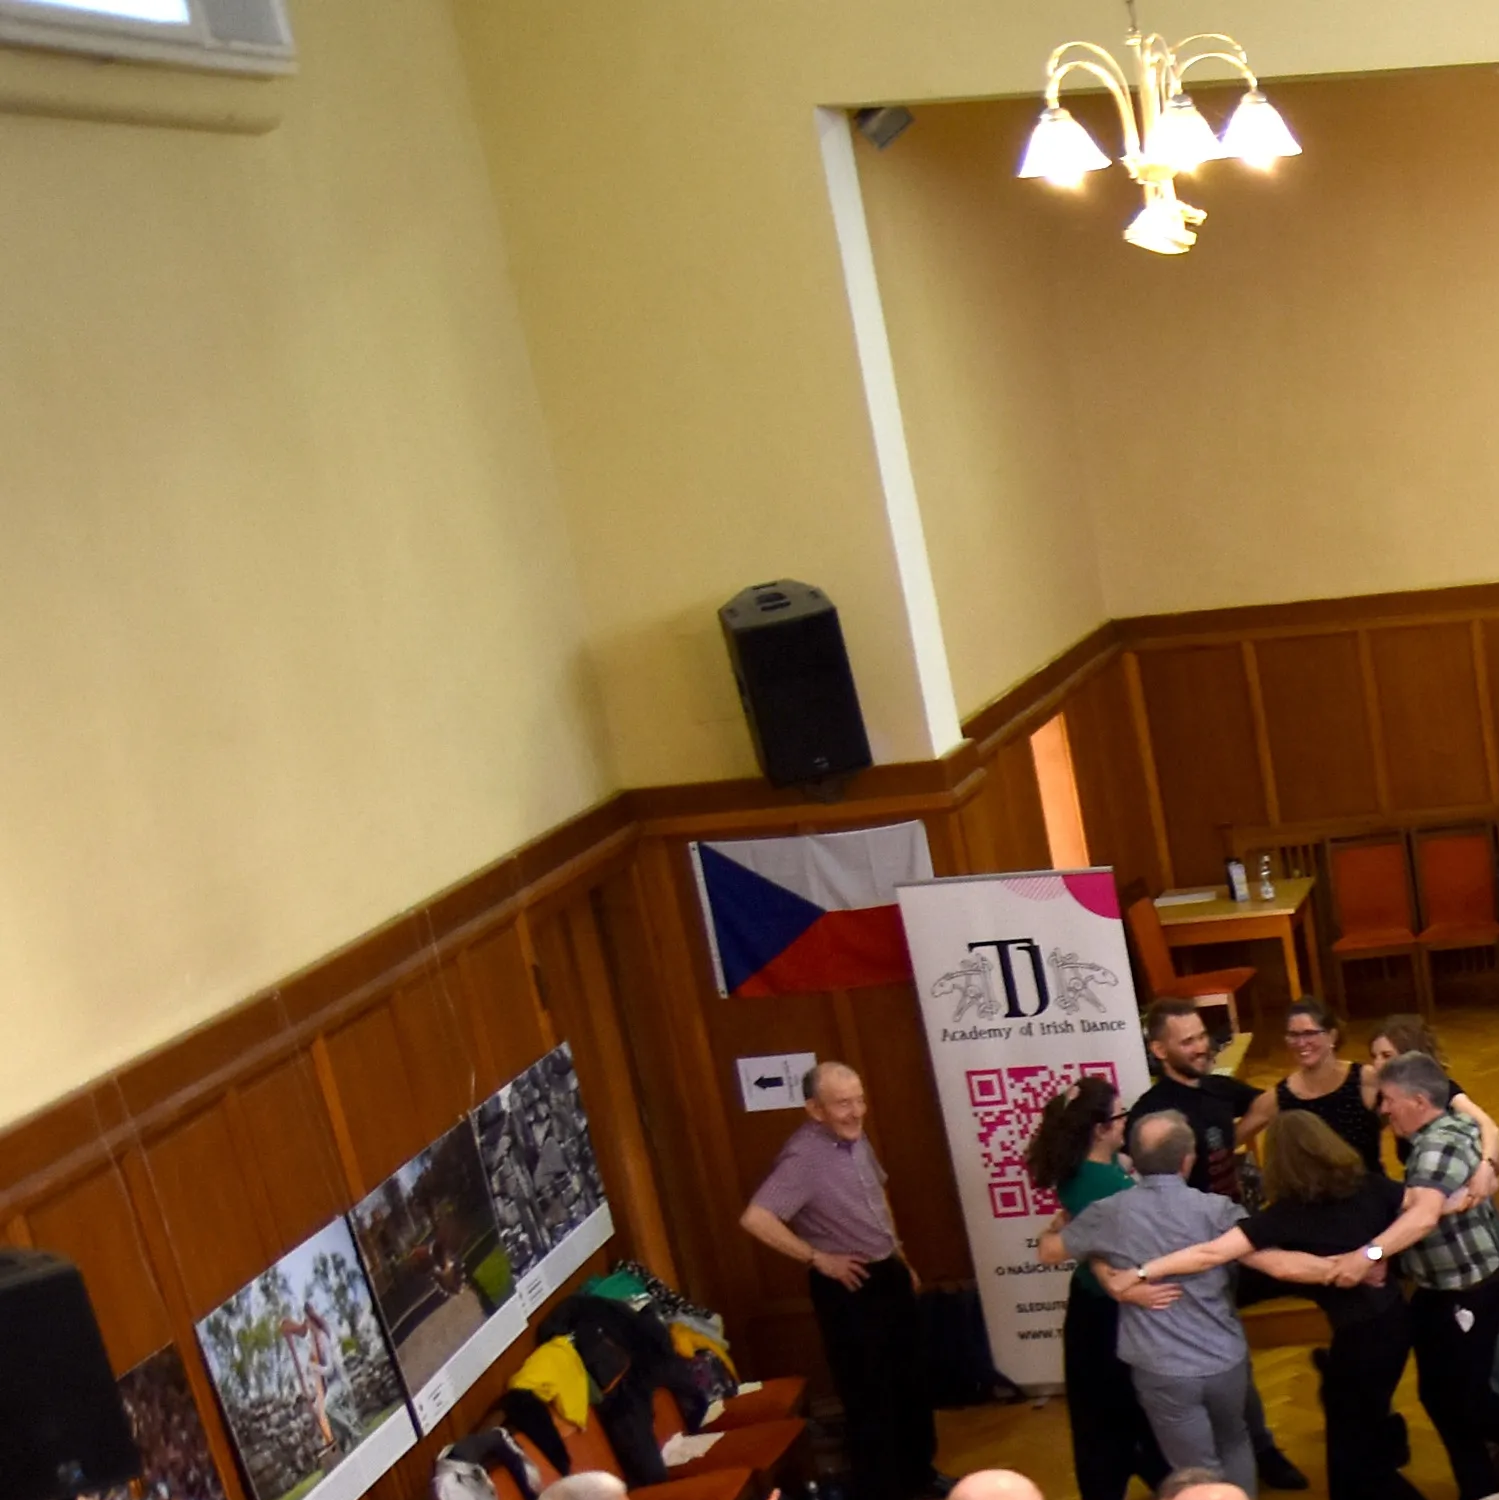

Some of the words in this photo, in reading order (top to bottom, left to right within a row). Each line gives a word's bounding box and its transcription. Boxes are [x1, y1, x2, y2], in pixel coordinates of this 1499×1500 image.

[941, 1025, 1012, 1042] Academy
[1019, 1021, 1034, 1037] of
[1081, 1019, 1126, 1034] Dance
